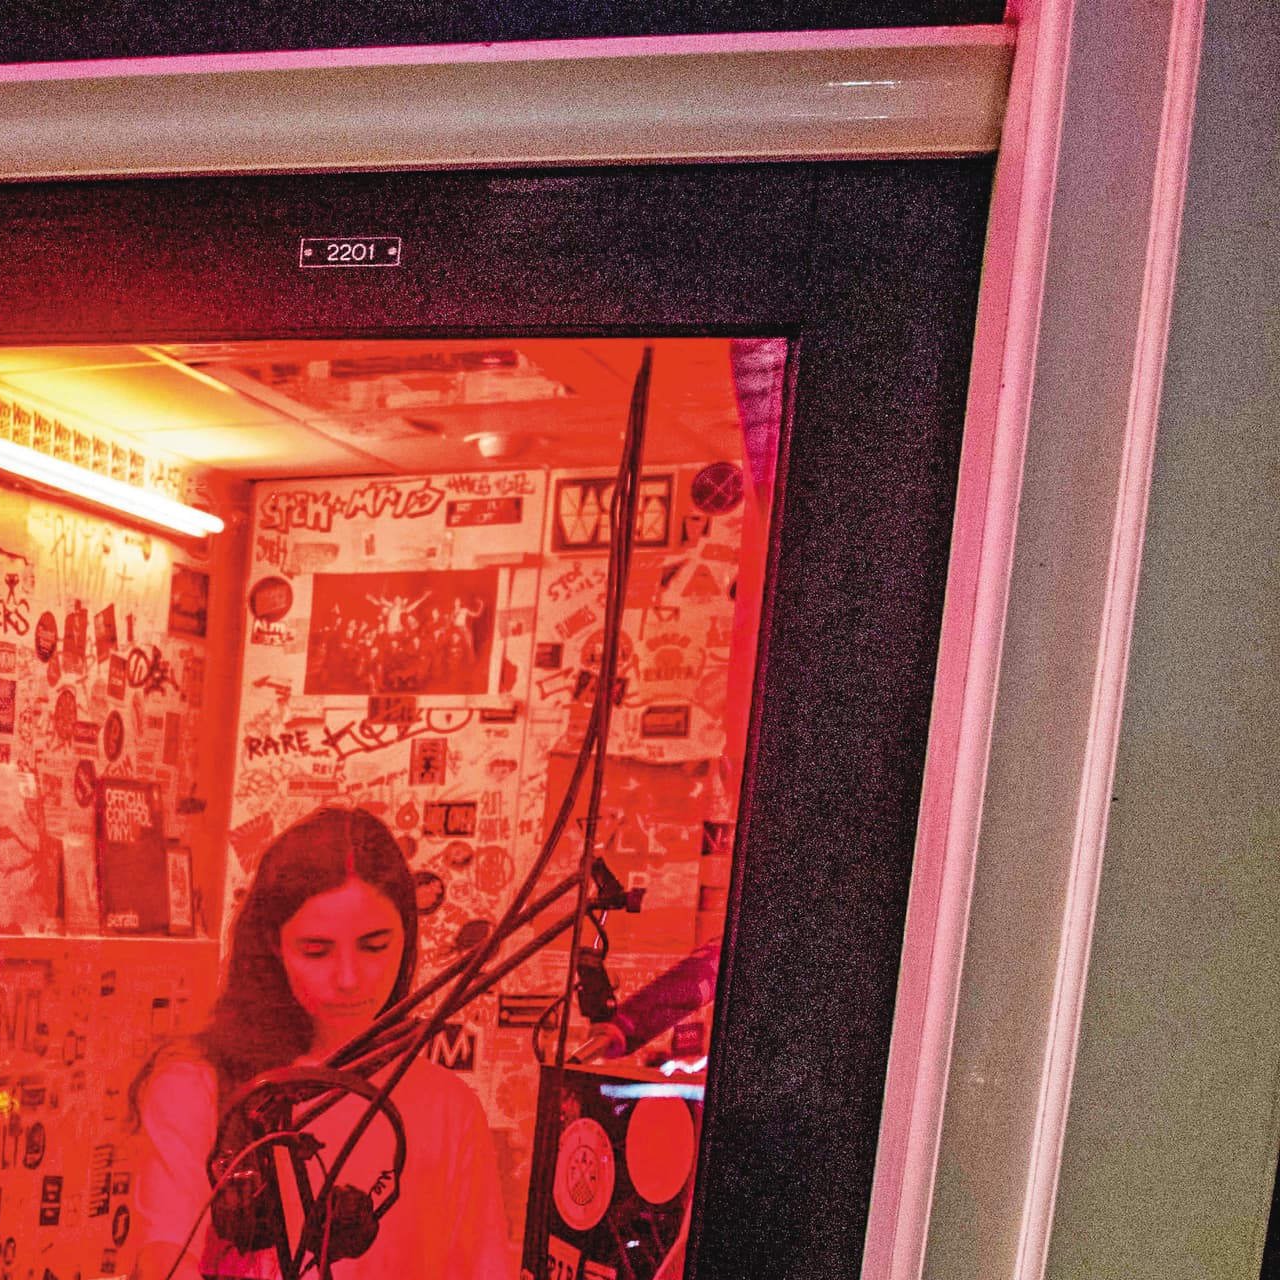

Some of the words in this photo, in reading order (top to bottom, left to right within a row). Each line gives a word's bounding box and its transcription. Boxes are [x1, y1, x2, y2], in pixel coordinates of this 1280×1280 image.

[327, 243, 376, 262] 2201
[244, 729, 309, 760] RARE
[106, 823, 136, 843] VINYL
